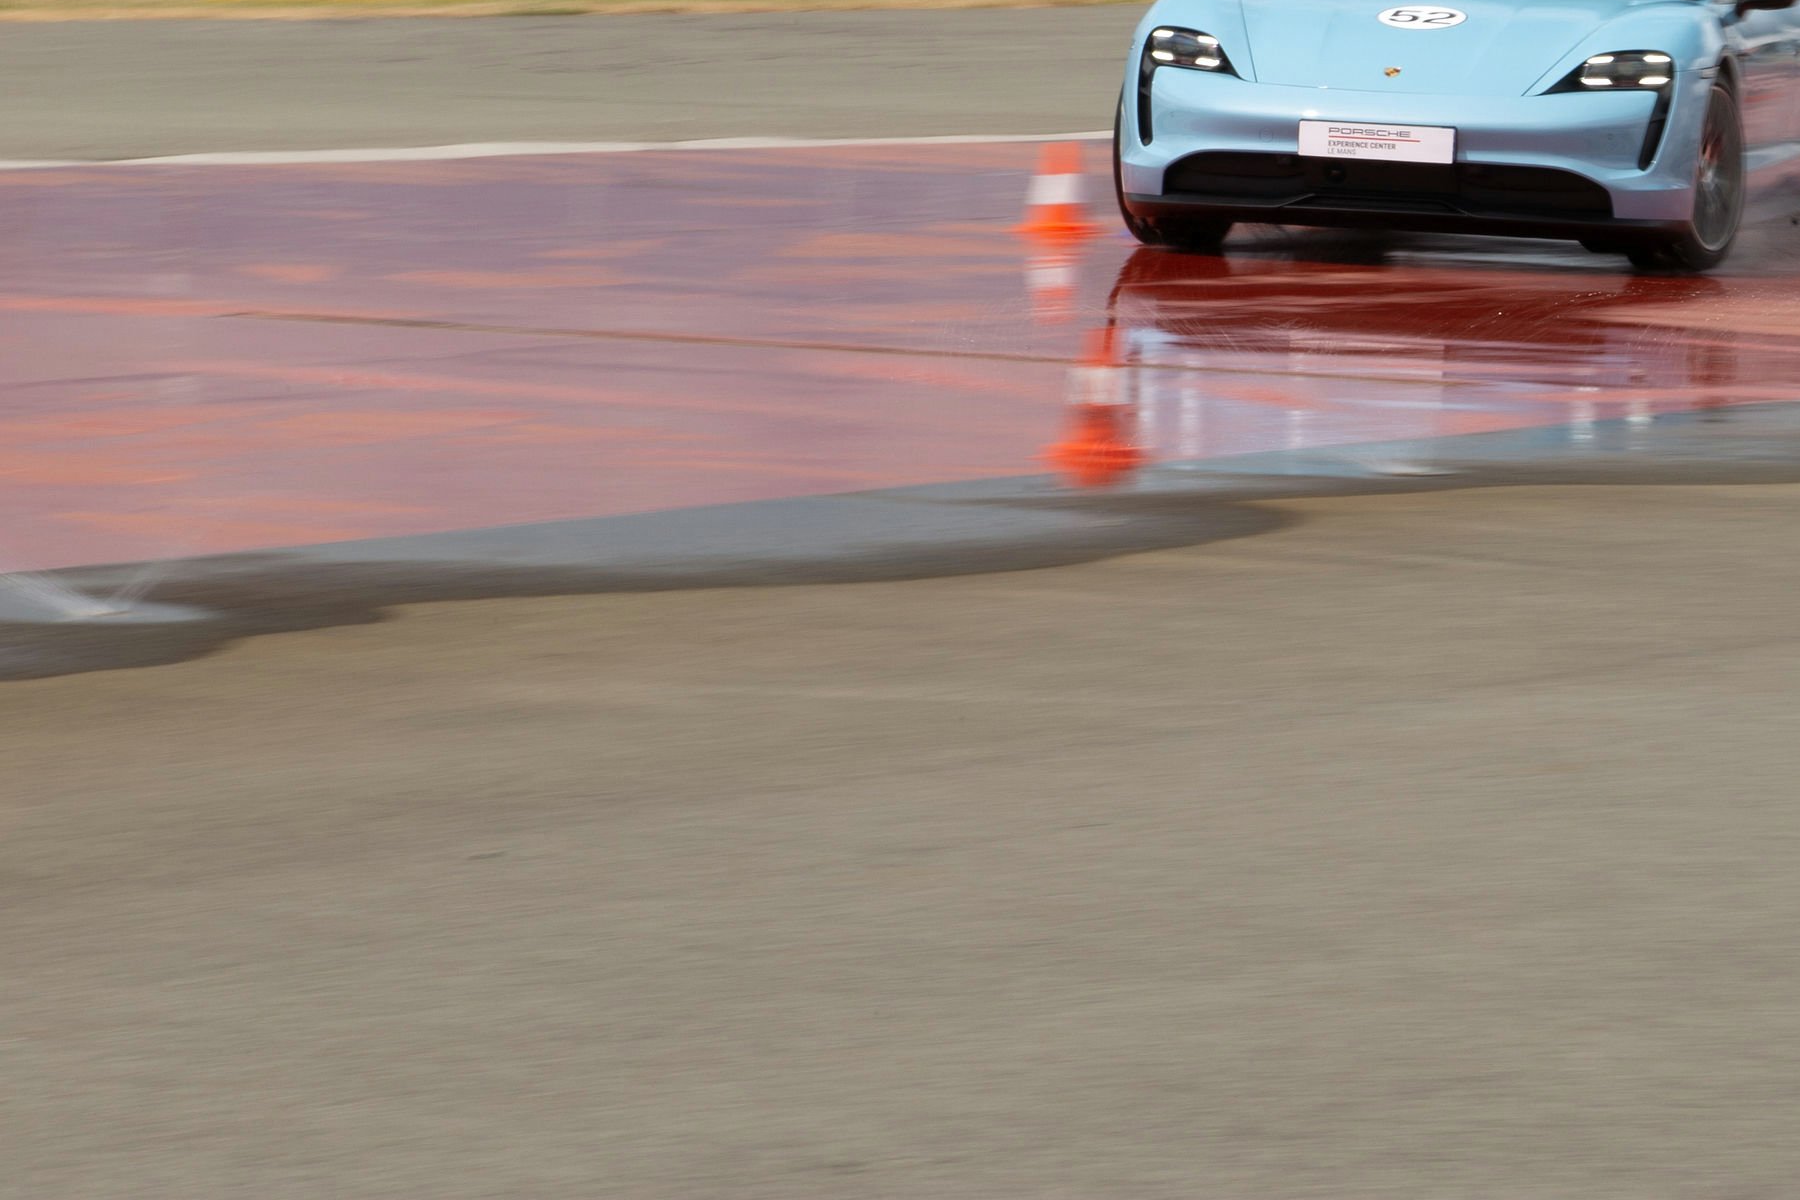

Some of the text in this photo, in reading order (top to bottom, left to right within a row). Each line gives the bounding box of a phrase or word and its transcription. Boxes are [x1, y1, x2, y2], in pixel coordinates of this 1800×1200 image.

[1388, 9, 1457, 25] 52
[1328, 126, 1411, 138] PORSCHE
[1327, 139, 1397, 150] EXPERIENCE CENTER
